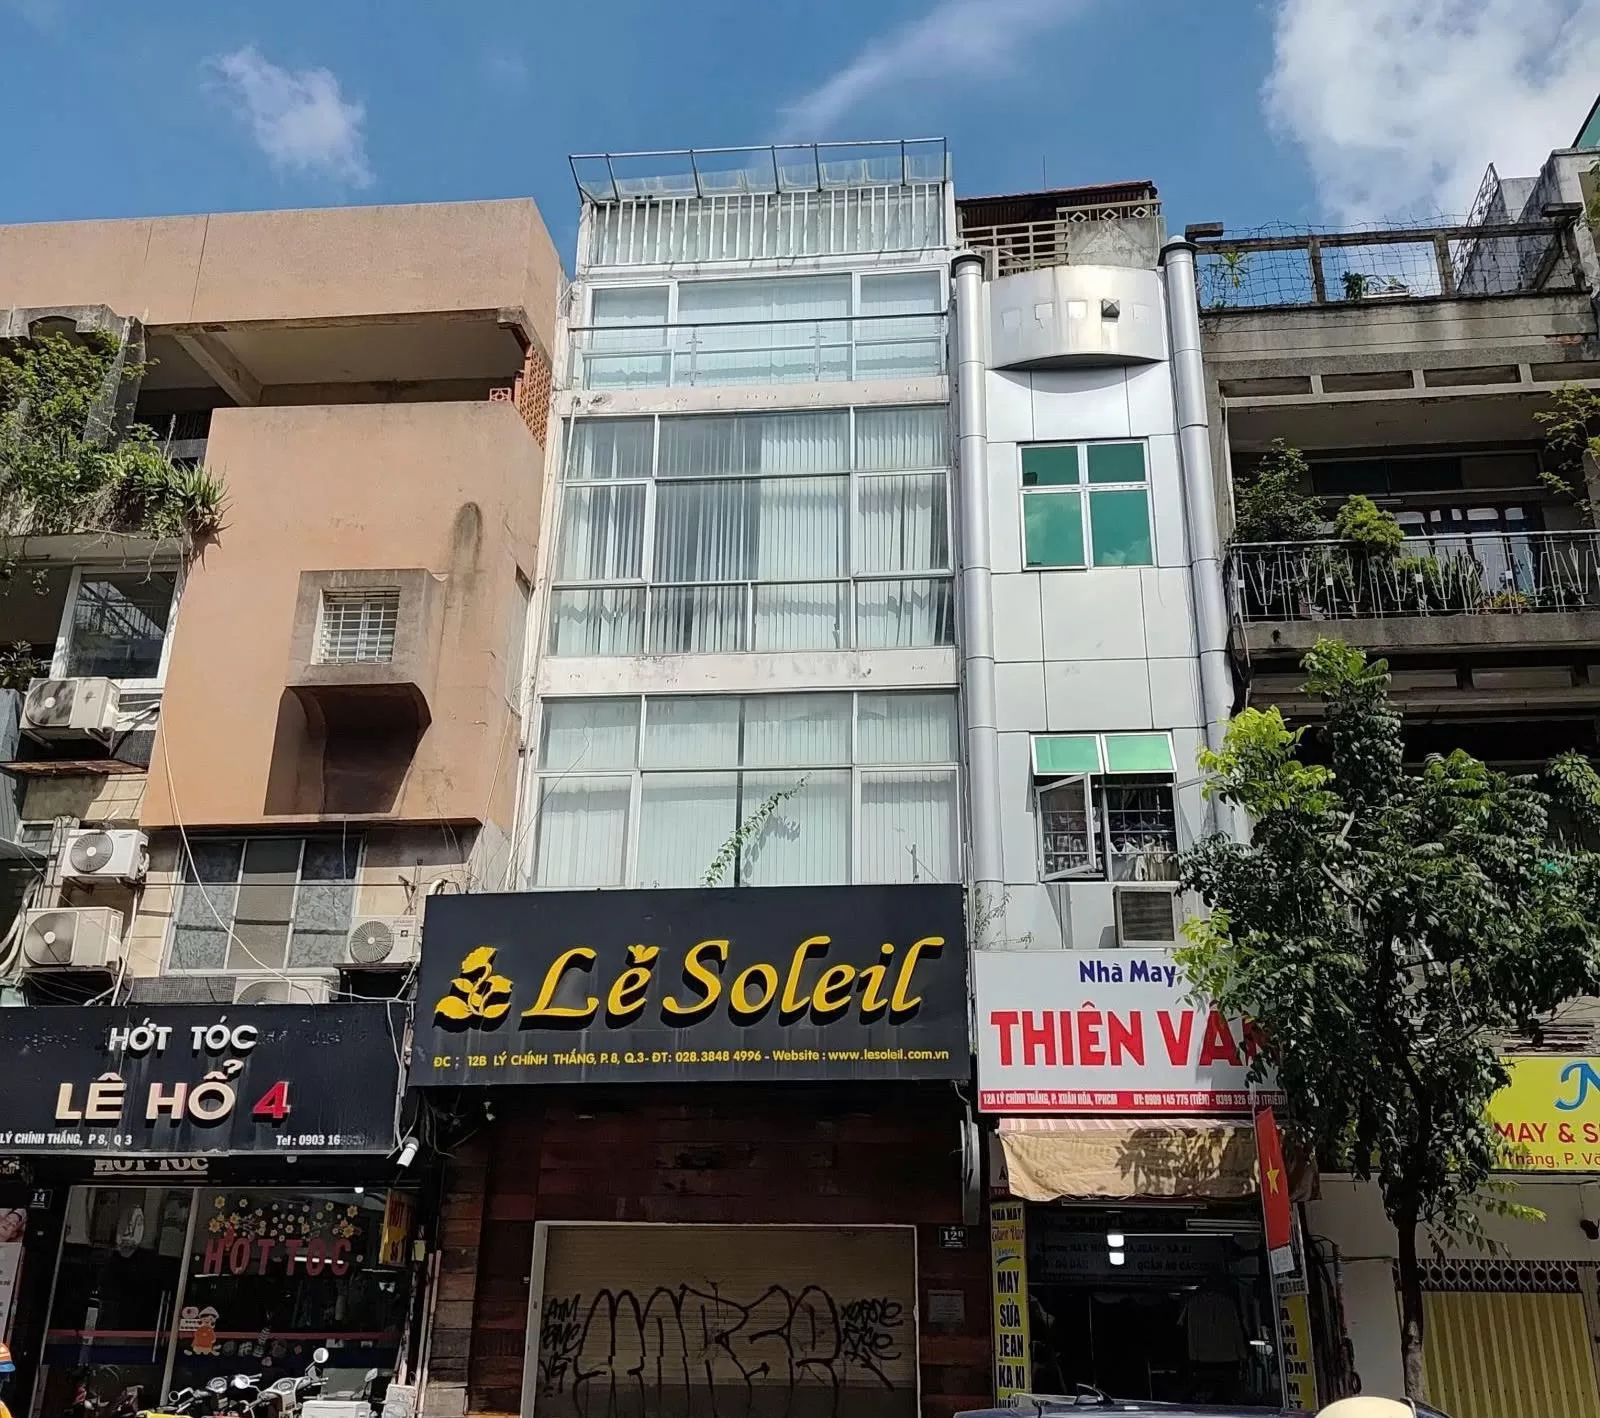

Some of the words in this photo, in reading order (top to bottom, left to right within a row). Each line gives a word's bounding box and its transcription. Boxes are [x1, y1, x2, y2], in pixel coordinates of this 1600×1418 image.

[664, 936, 945, 1015] Soleil
[1079, 960, 1123, 983] Nhà
[1130, 960, 1177, 987] May
[108, 1018, 172, 1051] HỚT
[191, 1015, 258, 1050] TÓC
[990, 1000, 1145, 1066] THIÊN
[433, 1056, 451, 1067] ĐC
[467, 1056, 487, 1067] 12B
[493, 1052, 507, 1066] LÝ
[511, 1051, 548, 1065] CHÍNH
[553, 1049, 597, 1065] THẮNG,
[675, 1051, 730, 1063] 028.3848
[733, 1050, 761, 1062] 4996
[828, 1048, 949, 1061] www.lesoleil.com.vn
[55, 1072, 127, 1120] LÊ
[145, 1059, 244, 1120] HỔ
[253, 1081, 291, 1119] 4
[14, 1131, 45, 1144] CHÍNH
[47, 1129, 83, 1146] THẮNG,
[299, 1134, 325, 1146] 0903
[1494, 1123, 1548, 1142] MAY
[1558, 1122, 1575, 1143] &
[1583, 1122, 1600, 1143] S
[997, 1271, 1020, 1293] MAY
[999, 1297, 1021, 1327] SỬA
[999, 1334, 1024, 1357] JEAN
